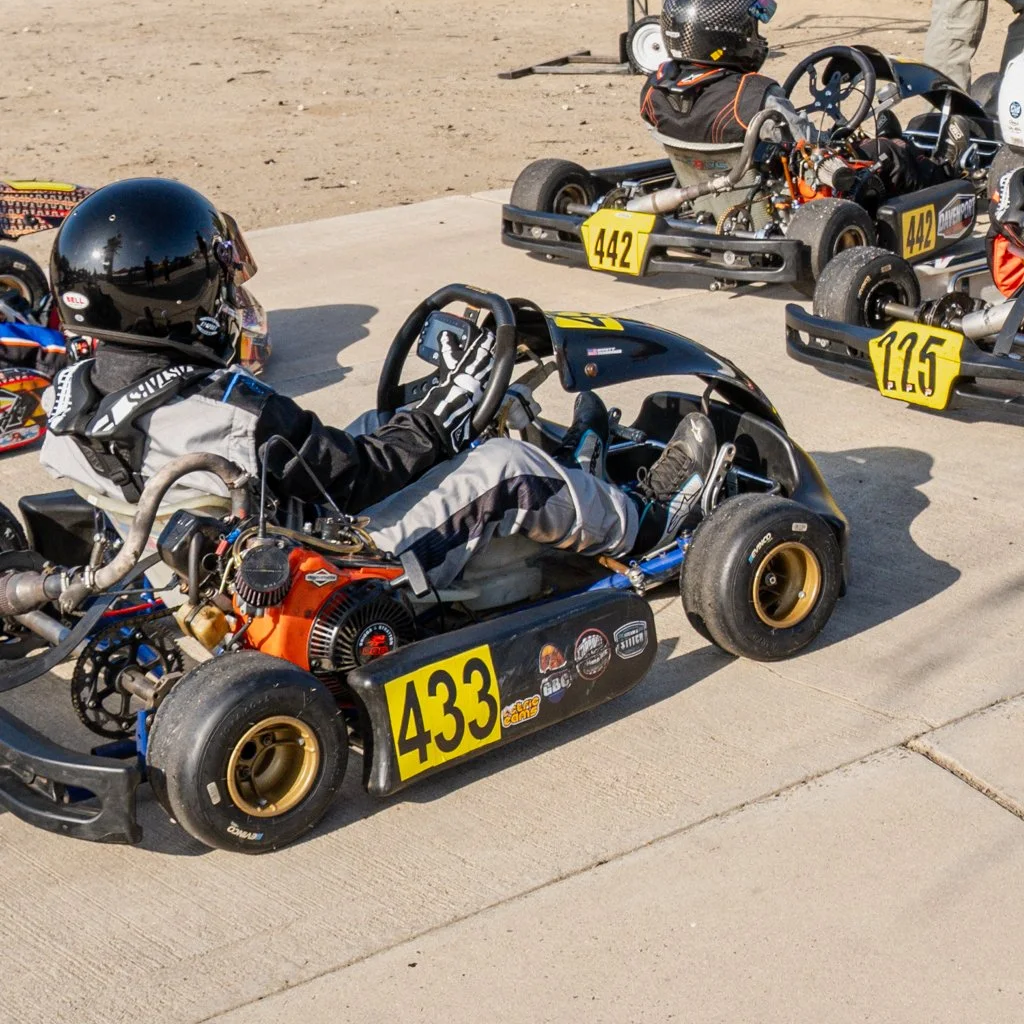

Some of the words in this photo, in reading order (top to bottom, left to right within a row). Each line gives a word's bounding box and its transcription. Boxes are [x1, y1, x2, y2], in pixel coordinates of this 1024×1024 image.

[906, 209, 933, 254] 442
[939, 196, 976, 229] DAVENPORT
[594, 228, 633, 268] 442
[66, 295, 85, 306] BELL
[877, 330, 947, 397] 225
[398, 657, 498, 764] 433
